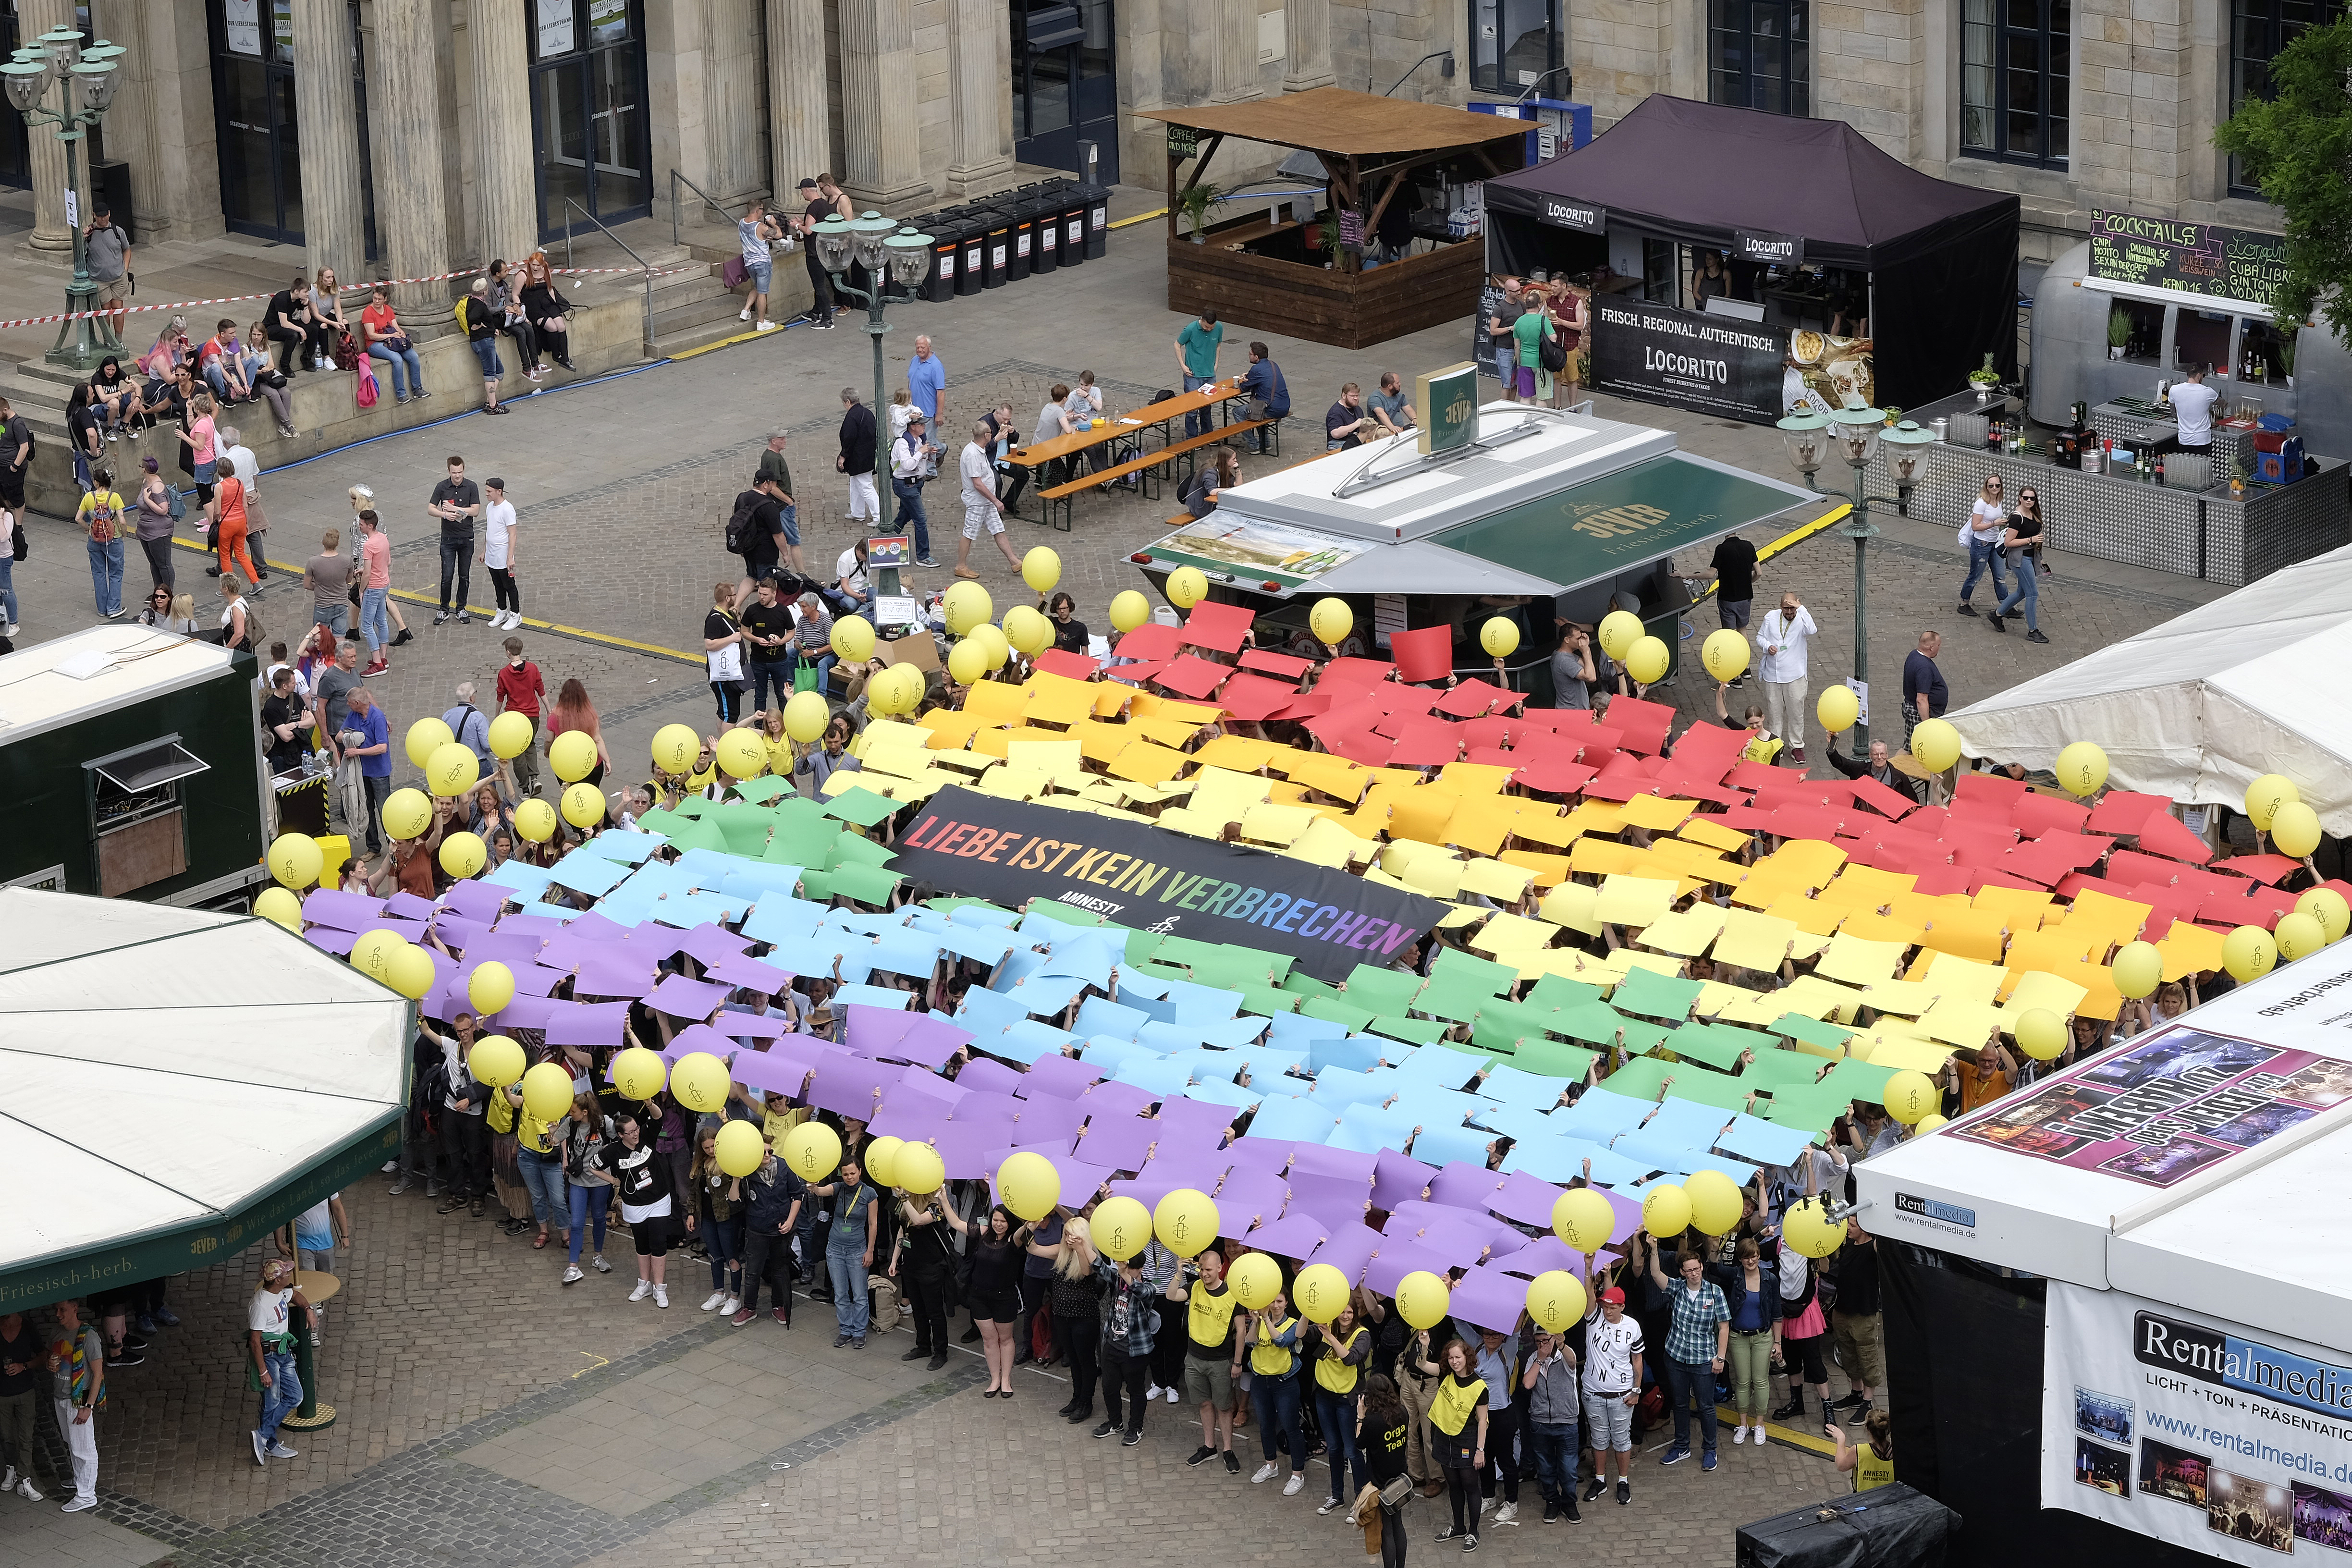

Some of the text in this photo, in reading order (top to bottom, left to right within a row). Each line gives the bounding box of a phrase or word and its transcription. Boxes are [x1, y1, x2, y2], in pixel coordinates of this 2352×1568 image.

[547, 16, 572, 29] LIEBESTRANK
[591, 104, 635, 120] staatsoper hannover
[230, 121, 270, 134] staatsoper hannover
[1168, 127, 1196, 142] COFFEE
[1168, 141, 1197, 154] AND MORE
[1548, 202, 1594, 225] LOCORITO
[2106, 215, 2197, 246] COCKTAILS
[1745, 237, 1792, 256] LOCORITO
[2092, 237, 2171, 261] CAIPI DAIQUIRI 5€
[2094, 246, 2119, 258] MOJITO
[2179, 253, 2205, 268] KURZE
[2179, 264, 2216, 277] WEISSWEIN
[2229, 261, 2259, 277] CUBA
[2163, 277, 2188, 292] PFAND
[2230, 275, 2249, 287] GIN
[2230, 285, 2266, 304] VODKA
[1602, 308, 1775, 352] FRISCH. REGIONAL. AUTHENTISCH.
[1645, 346, 1727, 384] LOCORITO
[1676, 379, 1695, 388] BURRITOS
[1445, 400, 1471, 424] JEVER
[1571, 504, 1671, 538] JEVER
[1274, 525, 1297, 534] Land,
[1307, 531, 1320, 539] das
[1321, 536, 1343, 544] Jever.
[1602, 513, 1723, 555] Friesisch-herb.
[904, 815, 1417, 955] LIEBE IST KEIN VERBRECHEN
[1057, 891, 1125, 915] AMNESTY
[2165, 1086, 2277, 1128] JEDEN
[246, 1213, 266, 1232] Wie
[270, 1203, 285, 1219] das
[290, 1184, 318, 1206] Land,
[320, 1175, 331, 1185] so
[334, 1163, 350, 1178] das
[354, 1146, 380, 1168] Jever.
[1899, 1195, 1969, 1223] Rentalmedia
[1895, 1213, 1976, 1239] www.rentalmedia.de
[0, 1237, 217, 1303] Friesisch-herb. JEVER
[1194, 1302, 1212, 1312] AMNESTY
[2143, 1319, 2352, 1410] Rentalmedia
[1441, 1384, 1455, 1401] AMNESTY
[2146, 1372, 2188, 1397] LICHT
[2204, 1389, 2234, 1408] TON
[2240, 1401, 2247, 1409] +
[1384, 1424, 1406, 1442] Orga
[2146, 1410, 2352, 1487] www.rentalmedia.d
